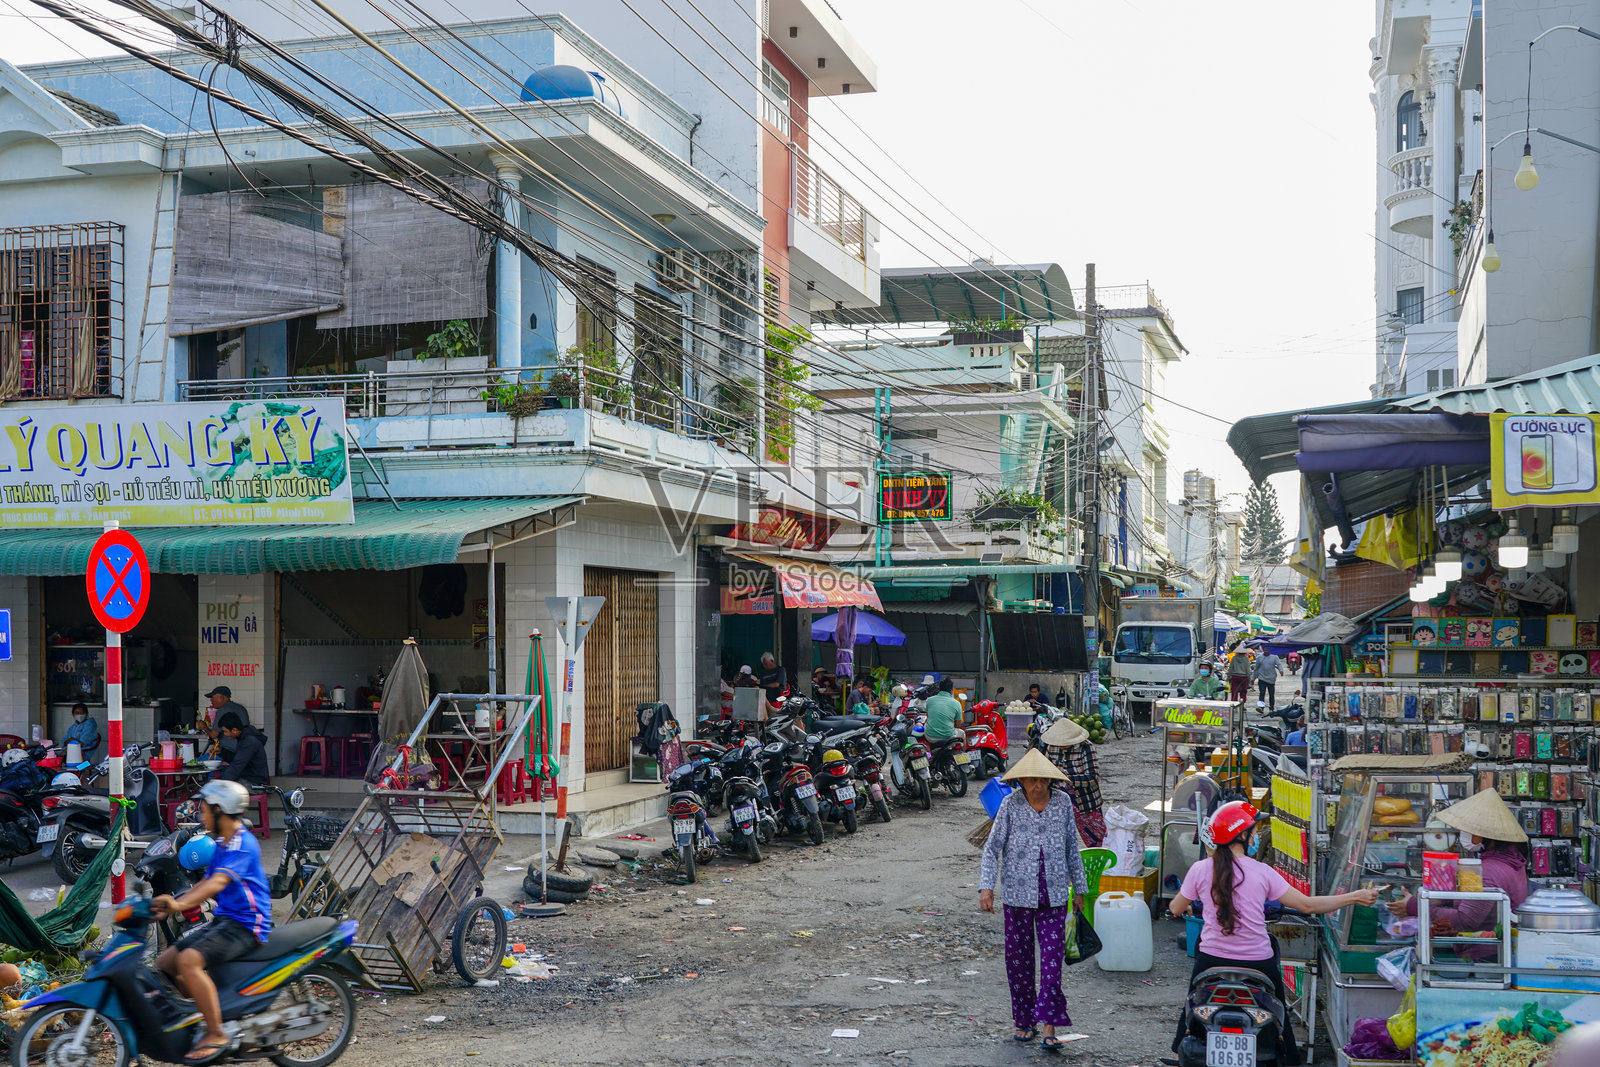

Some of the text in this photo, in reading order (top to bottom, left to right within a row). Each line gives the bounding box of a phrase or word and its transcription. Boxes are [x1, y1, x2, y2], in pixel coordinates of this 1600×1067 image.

[1511, 420, 1586, 436] CƯỜNG LỰC
[0, 405, 321, 477] Ý QUANG KÝ
[3, 482, 59, 504] THÁNH,
[61, 480, 82, 503] MÌ
[84, 481, 111, 505] SỢI
[122, 476, 144, 501] HỦ
[146, 476, 181, 501] TIẾU
[184, 477, 211, 501] MÌ,
[212, 475, 234, 499] HỦ
[236, 474, 272, 498] TIẾU
[275, 476, 331, 498] XƯƠNG
[906, 476, 924, 488] TIỆM
[883, 489, 948, 509] MINH VY
[931, 508, 944, 517] 478
[206, 593, 242, 620] PHỞ
[244, 611, 257, 632] GÀ
[1165, 707, 1223, 726] Nước Mía
[1215, 1036, 1248, 1051] 86-B8
[1211, 1051, 1252, 1067] 186.85
